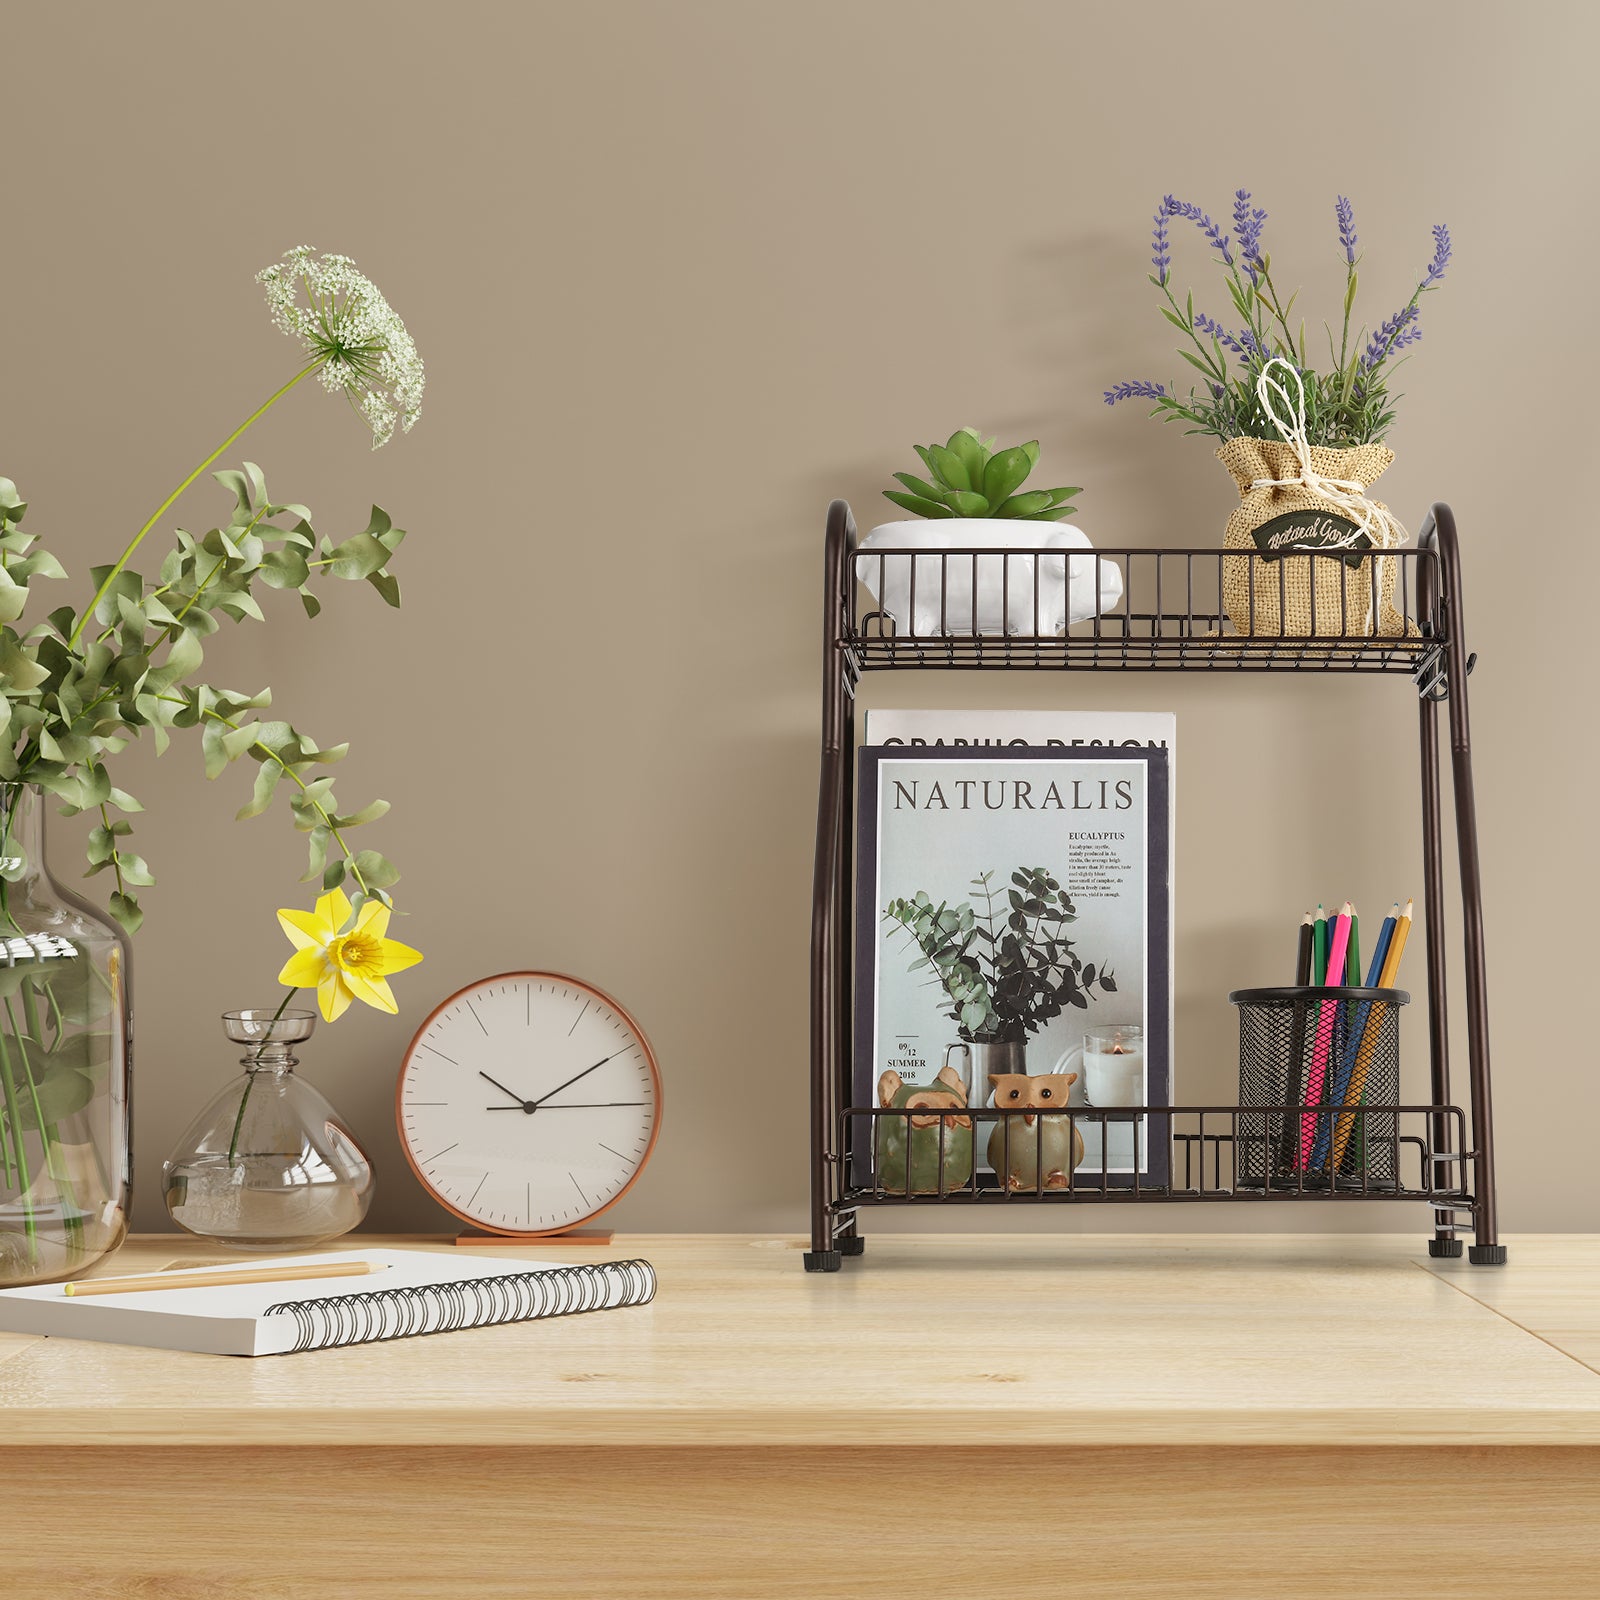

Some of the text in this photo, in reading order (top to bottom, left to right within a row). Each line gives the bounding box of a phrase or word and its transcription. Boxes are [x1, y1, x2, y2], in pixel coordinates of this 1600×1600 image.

[892, 780, 1134, 811] NATURALIS
[1069, 832, 1125, 840] EUCALYPTUS
[887, 1059, 926, 1067] SUMMER
[899, 1071, 916, 1079] 2018
